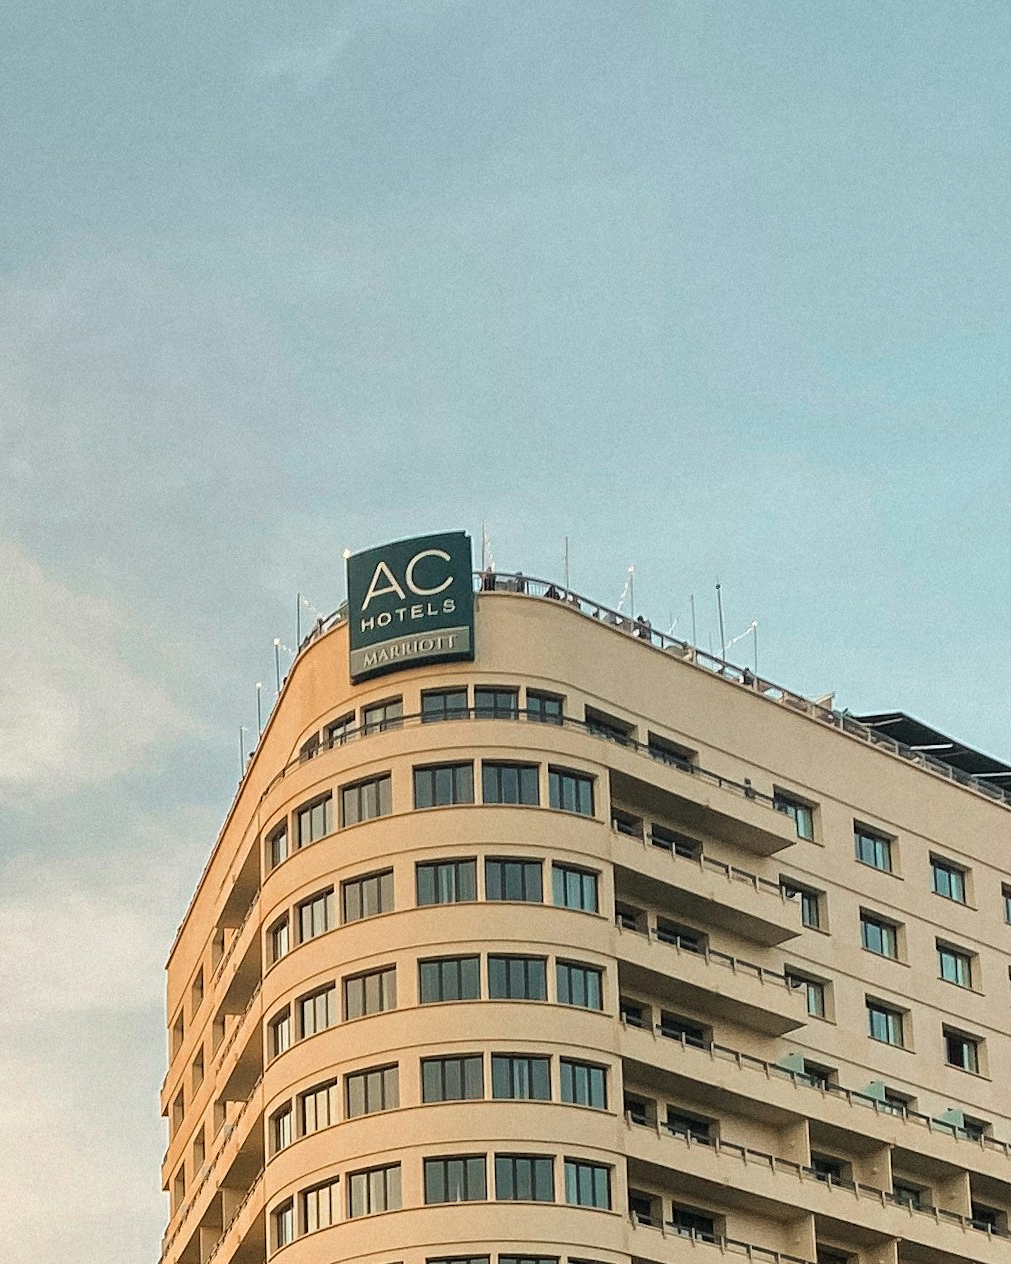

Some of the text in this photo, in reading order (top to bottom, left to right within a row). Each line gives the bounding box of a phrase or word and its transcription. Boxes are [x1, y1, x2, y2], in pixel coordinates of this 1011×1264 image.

[361, 549, 454, 611] AC
[361, 599, 456, 633] HOTELS
[363, 633, 457, 668] MARRIOTT
